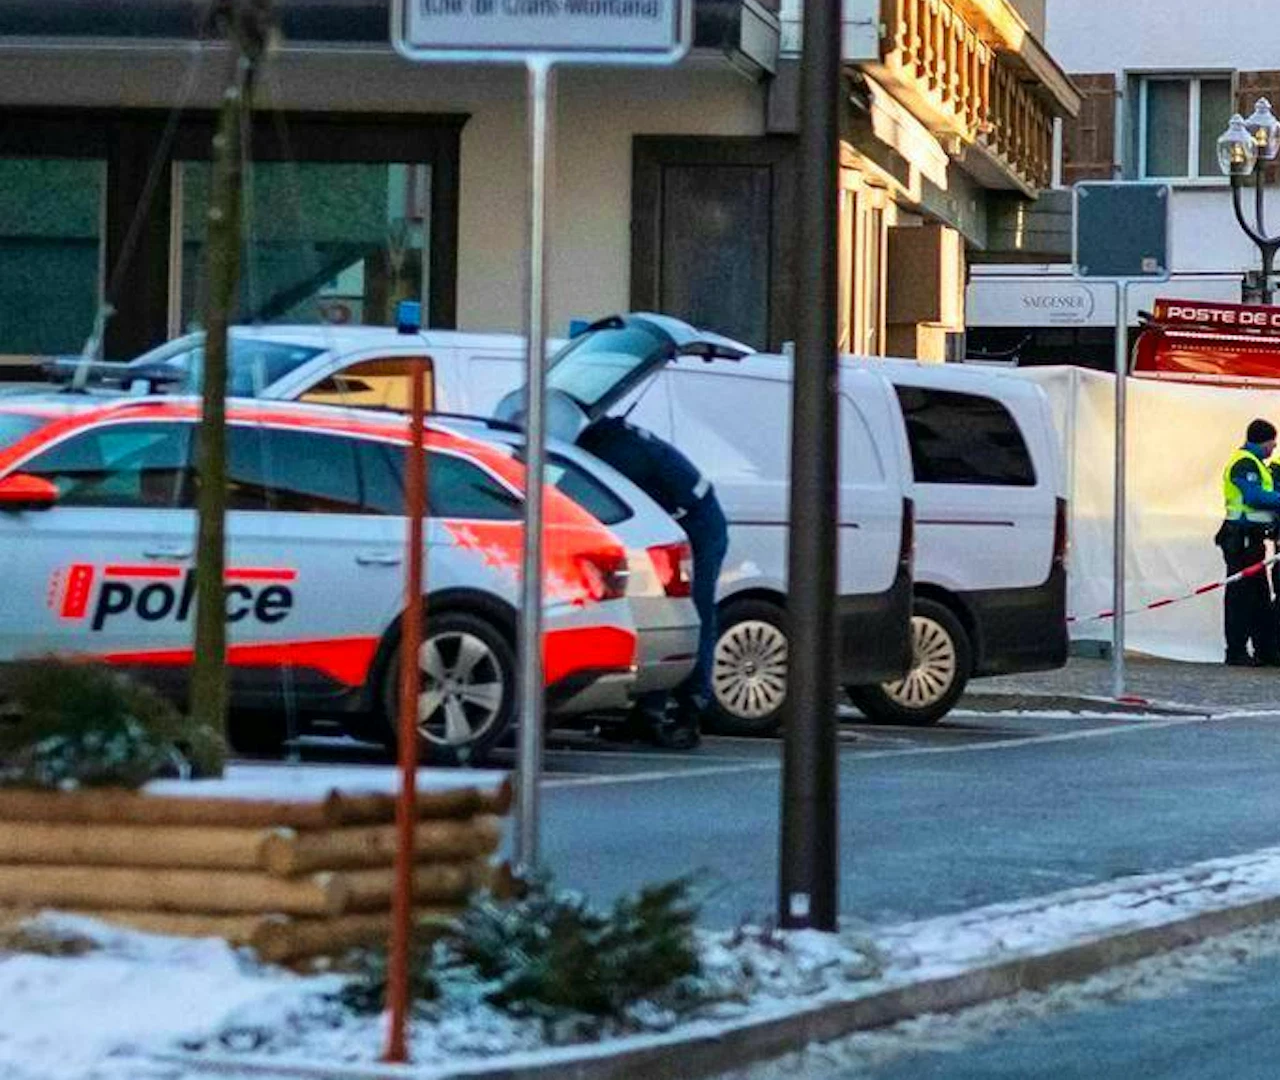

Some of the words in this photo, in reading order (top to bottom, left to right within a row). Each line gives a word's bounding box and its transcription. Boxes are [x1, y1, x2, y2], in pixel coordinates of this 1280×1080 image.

[1167, 306, 1235, 322] POSTE
[1239, 311, 1268, 325] DE
[91, 567, 293, 632] polce
